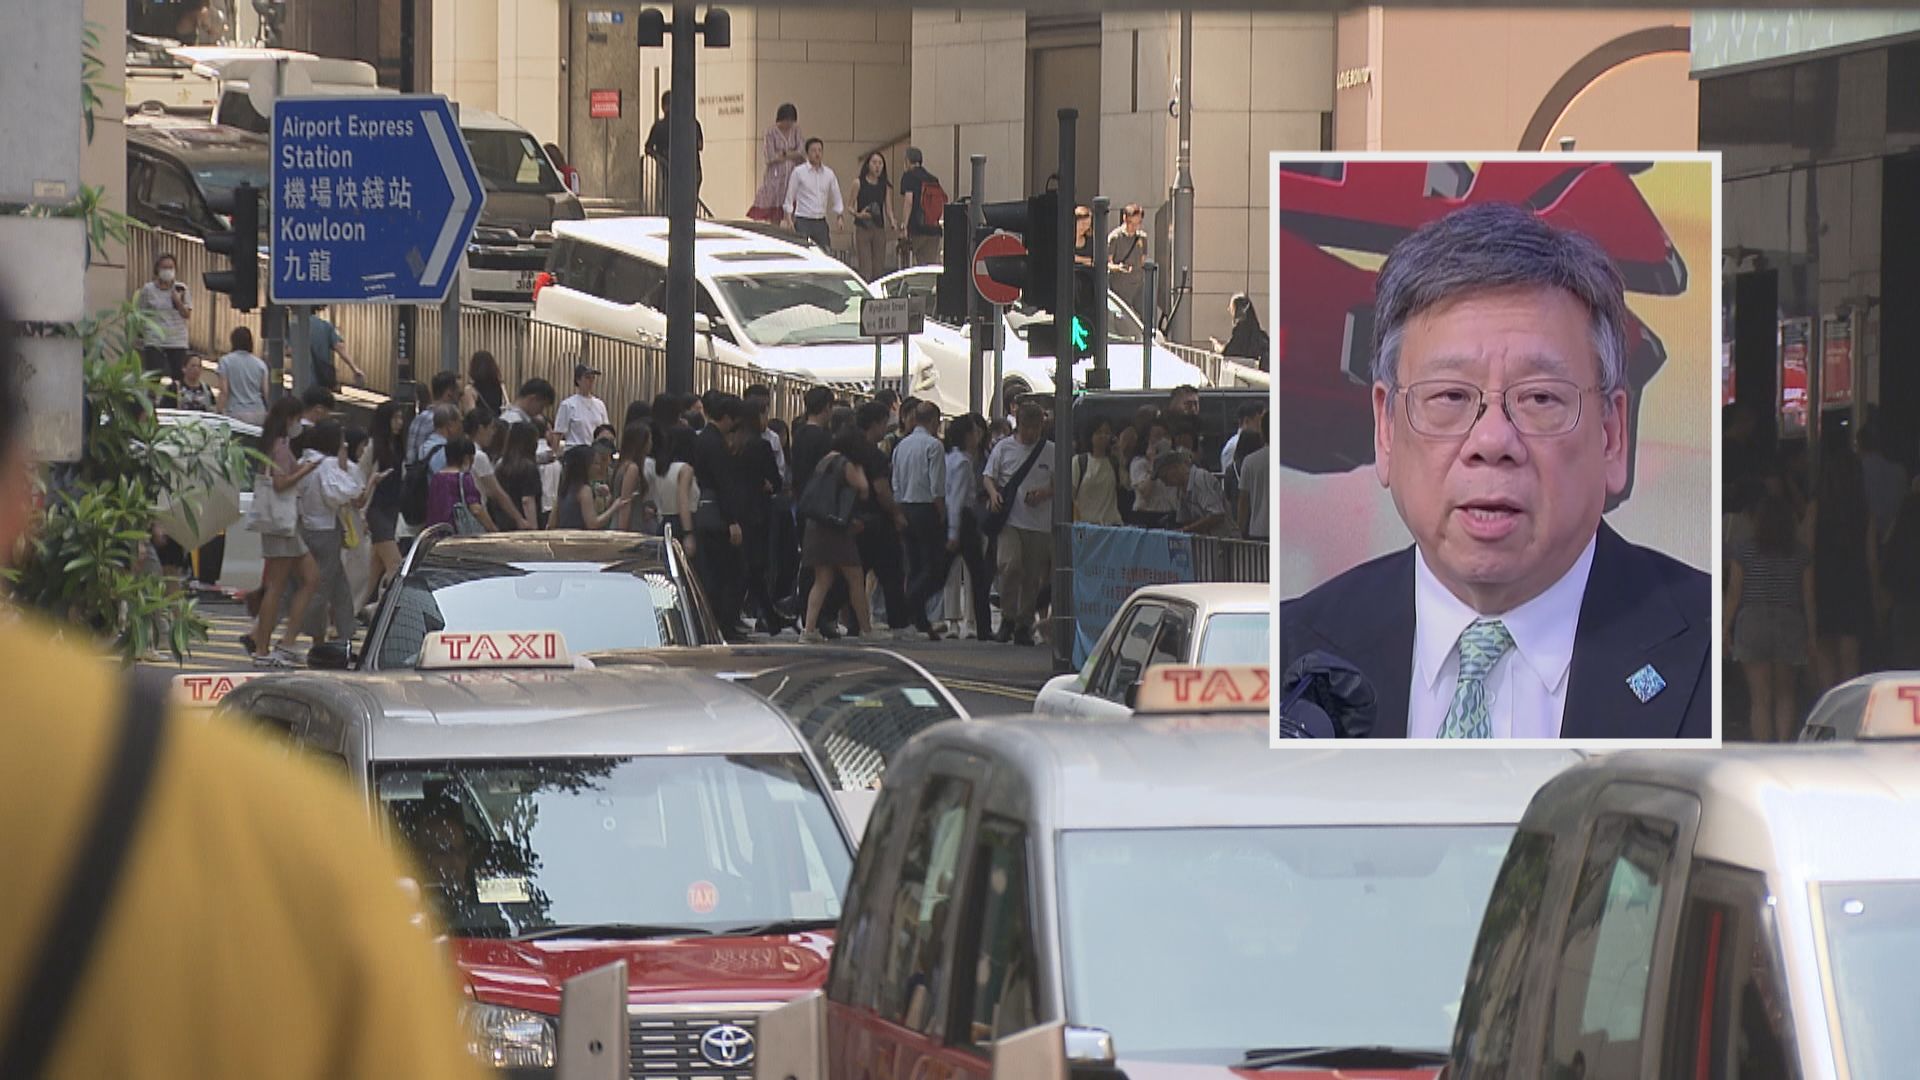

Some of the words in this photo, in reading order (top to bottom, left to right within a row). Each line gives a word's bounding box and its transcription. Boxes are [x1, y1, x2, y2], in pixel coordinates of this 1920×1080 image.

[282, 115, 341, 141] Airport
[349, 114, 414, 140] Express
[282, 145, 353, 169] Station
[283, 175, 412, 209] 機場快綫站
[281, 216, 366, 242] Kowloon
[283, 248, 332, 282] 九龍
[441, 633, 556, 661] TAXI
[1163, 668, 1270, 702] TA
